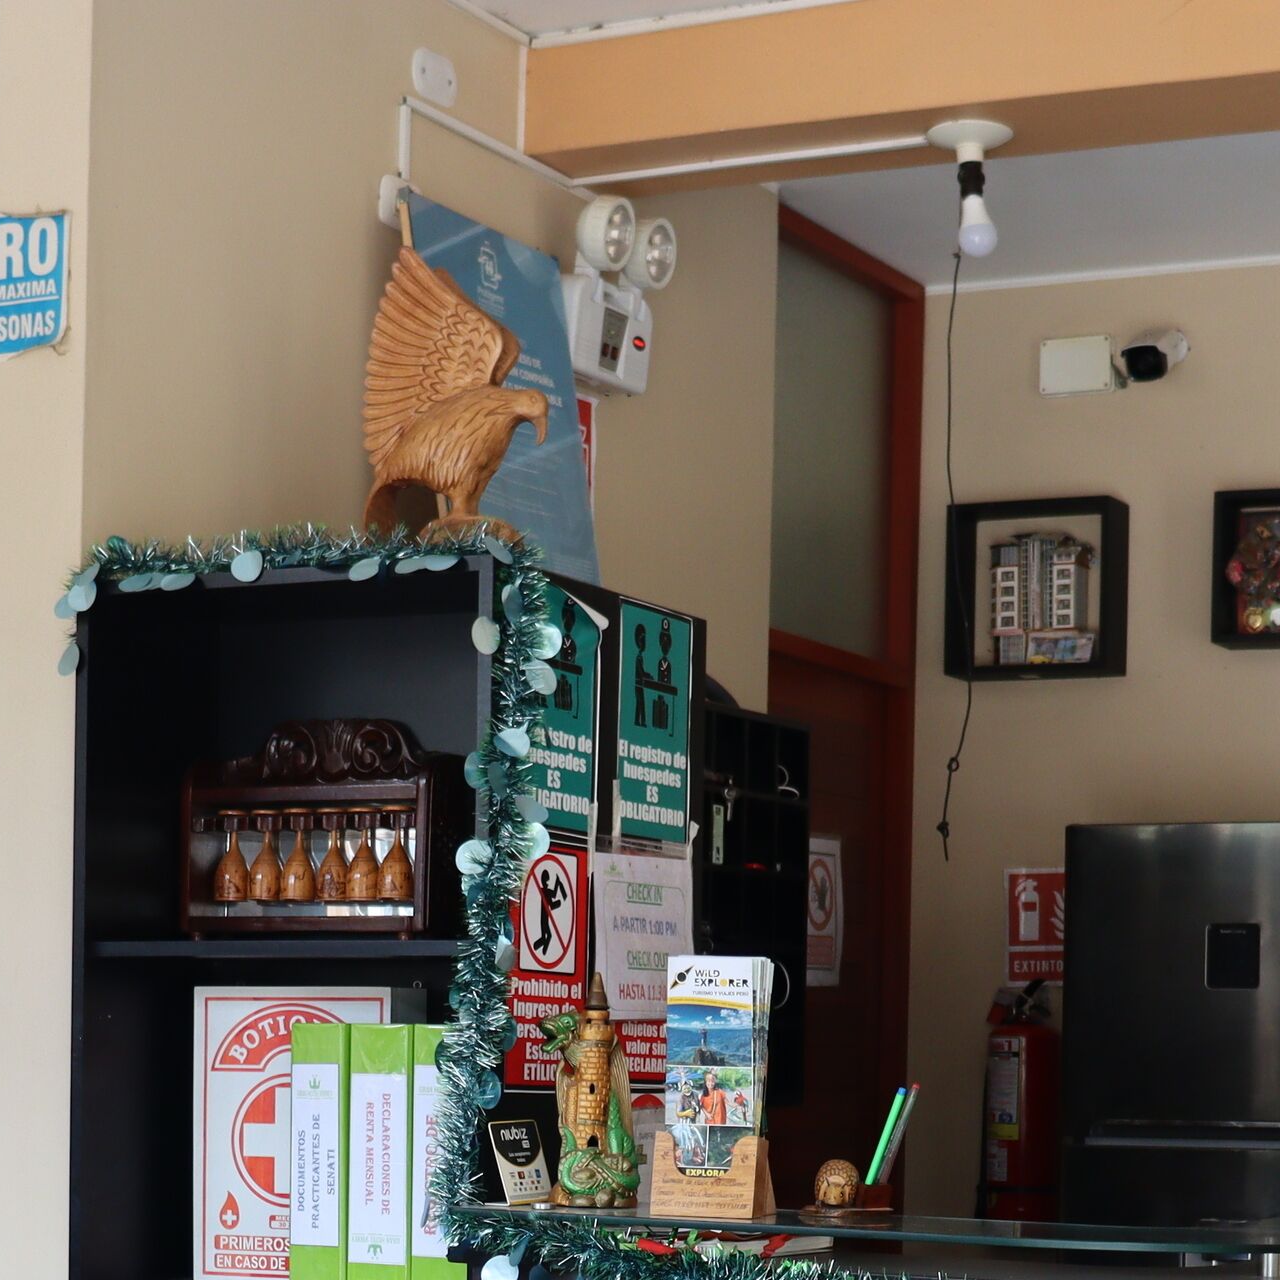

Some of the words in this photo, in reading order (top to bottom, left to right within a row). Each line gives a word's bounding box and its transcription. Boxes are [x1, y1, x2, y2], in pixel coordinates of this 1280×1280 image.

[577, 734, 592, 754] de
[619, 738, 629, 758] El
[629, 741, 673, 767] registro
[673, 751, 687, 770] de
[546, 768, 562, 789] ES
[623, 760, 682, 789] huespedes
[645, 785, 659, 803] ES
[619, 799, 685, 828] OBLIGATORIO
[626, 882, 652, 902] CHECK
[653, 886, 663, 903] IN
[613, 915, 619, 931] A
[621, 916, 647, 935] PARTIR
[649, 920, 664, 936] 1:00
[665, 920, 678, 937] PM
[626, 950, 651, 967] CHECK
[511, 976, 571, 999] Prohibido
[572, 981, 582, 1000] el
[619, 983, 646, 1000] HASTA
[694, 978, 749, 988] EXPLORER
[513, 998, 560, 1019] Ingreso
[228, 1015, 322, 1064] BOTI
[622, 1021, 658, 1038] objetos
[625, 1040, 651, 1055] valor
[651, 1040, 666, 1056] sin
[312, 1113, 321, 1130] DE
[365, 1101, 375, 1143] RENTA
[381, 1093, 391, 1198] DECLARACIONES
[297, 1129, 306, 1212] DOCUMENTOS
[326, 1148, 336, 1196] SENATI
[365, 1147, 375, 1206] MENSUAL
[311, 1133, 321, 1230] PRACTICANTES
[381, 1199, 391, 1216] DE
[216, 1254, 232, 1268] EN
[234, 1255, 267, 1269] CASO
[270, 1256, 286, 1270] DE
